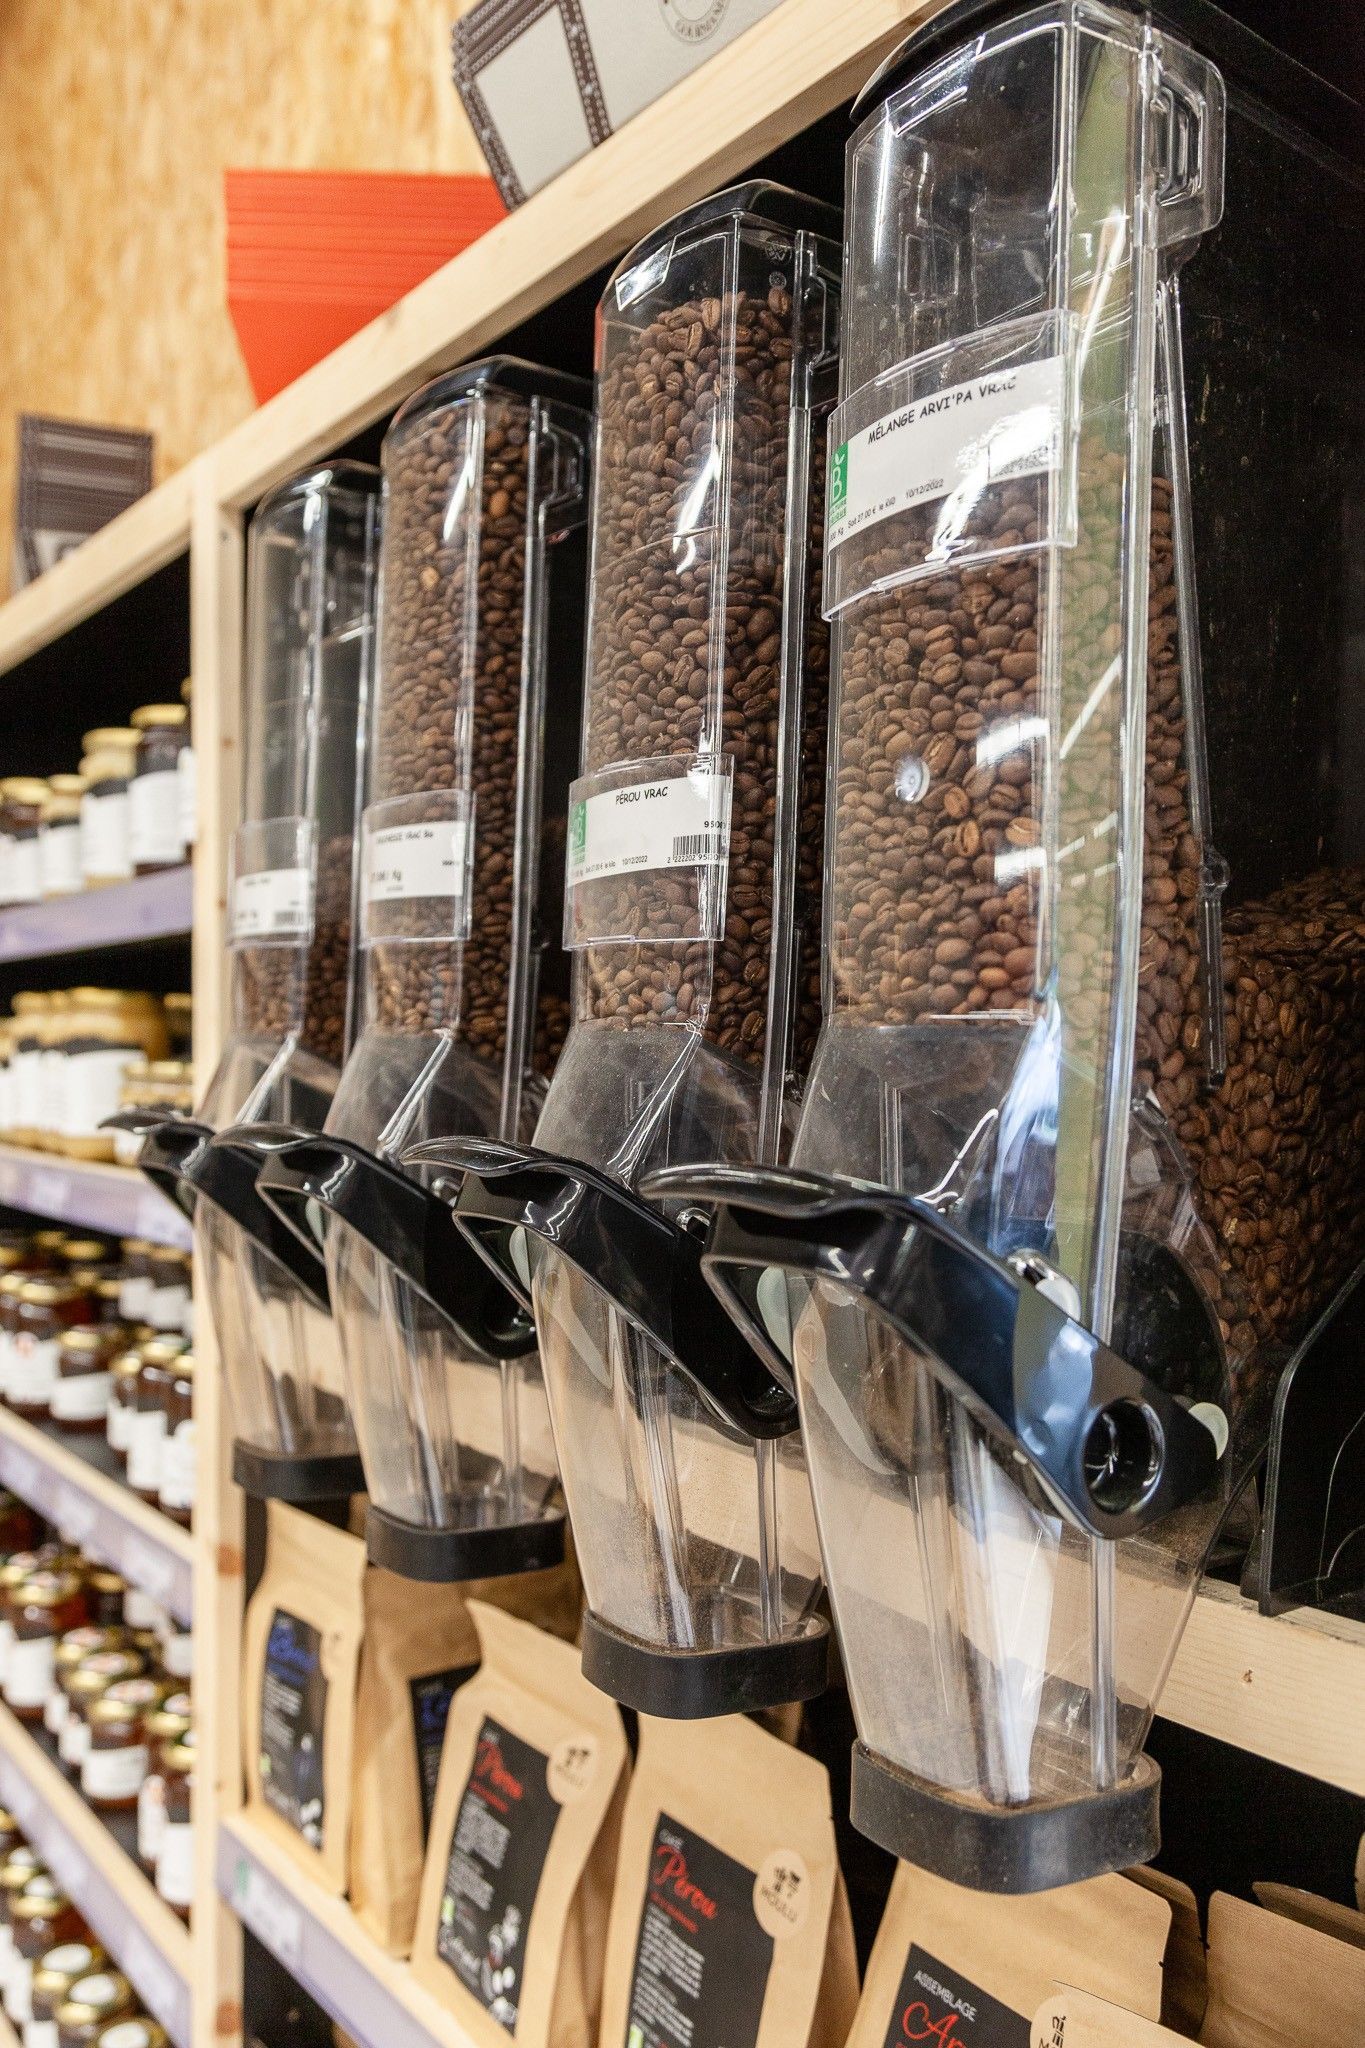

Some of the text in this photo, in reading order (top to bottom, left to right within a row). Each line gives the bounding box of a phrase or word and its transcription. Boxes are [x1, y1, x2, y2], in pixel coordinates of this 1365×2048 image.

[868, 409, 915, 444] MÉLANGE
[919, 389, 973, 418] ARVI'PA
[905, 478, 945, 499] 10/12/2022
[615, 786, 669, 805] PÉROU VRAC
[913, 1970, 977, 2022] ASSEMBLAGE
